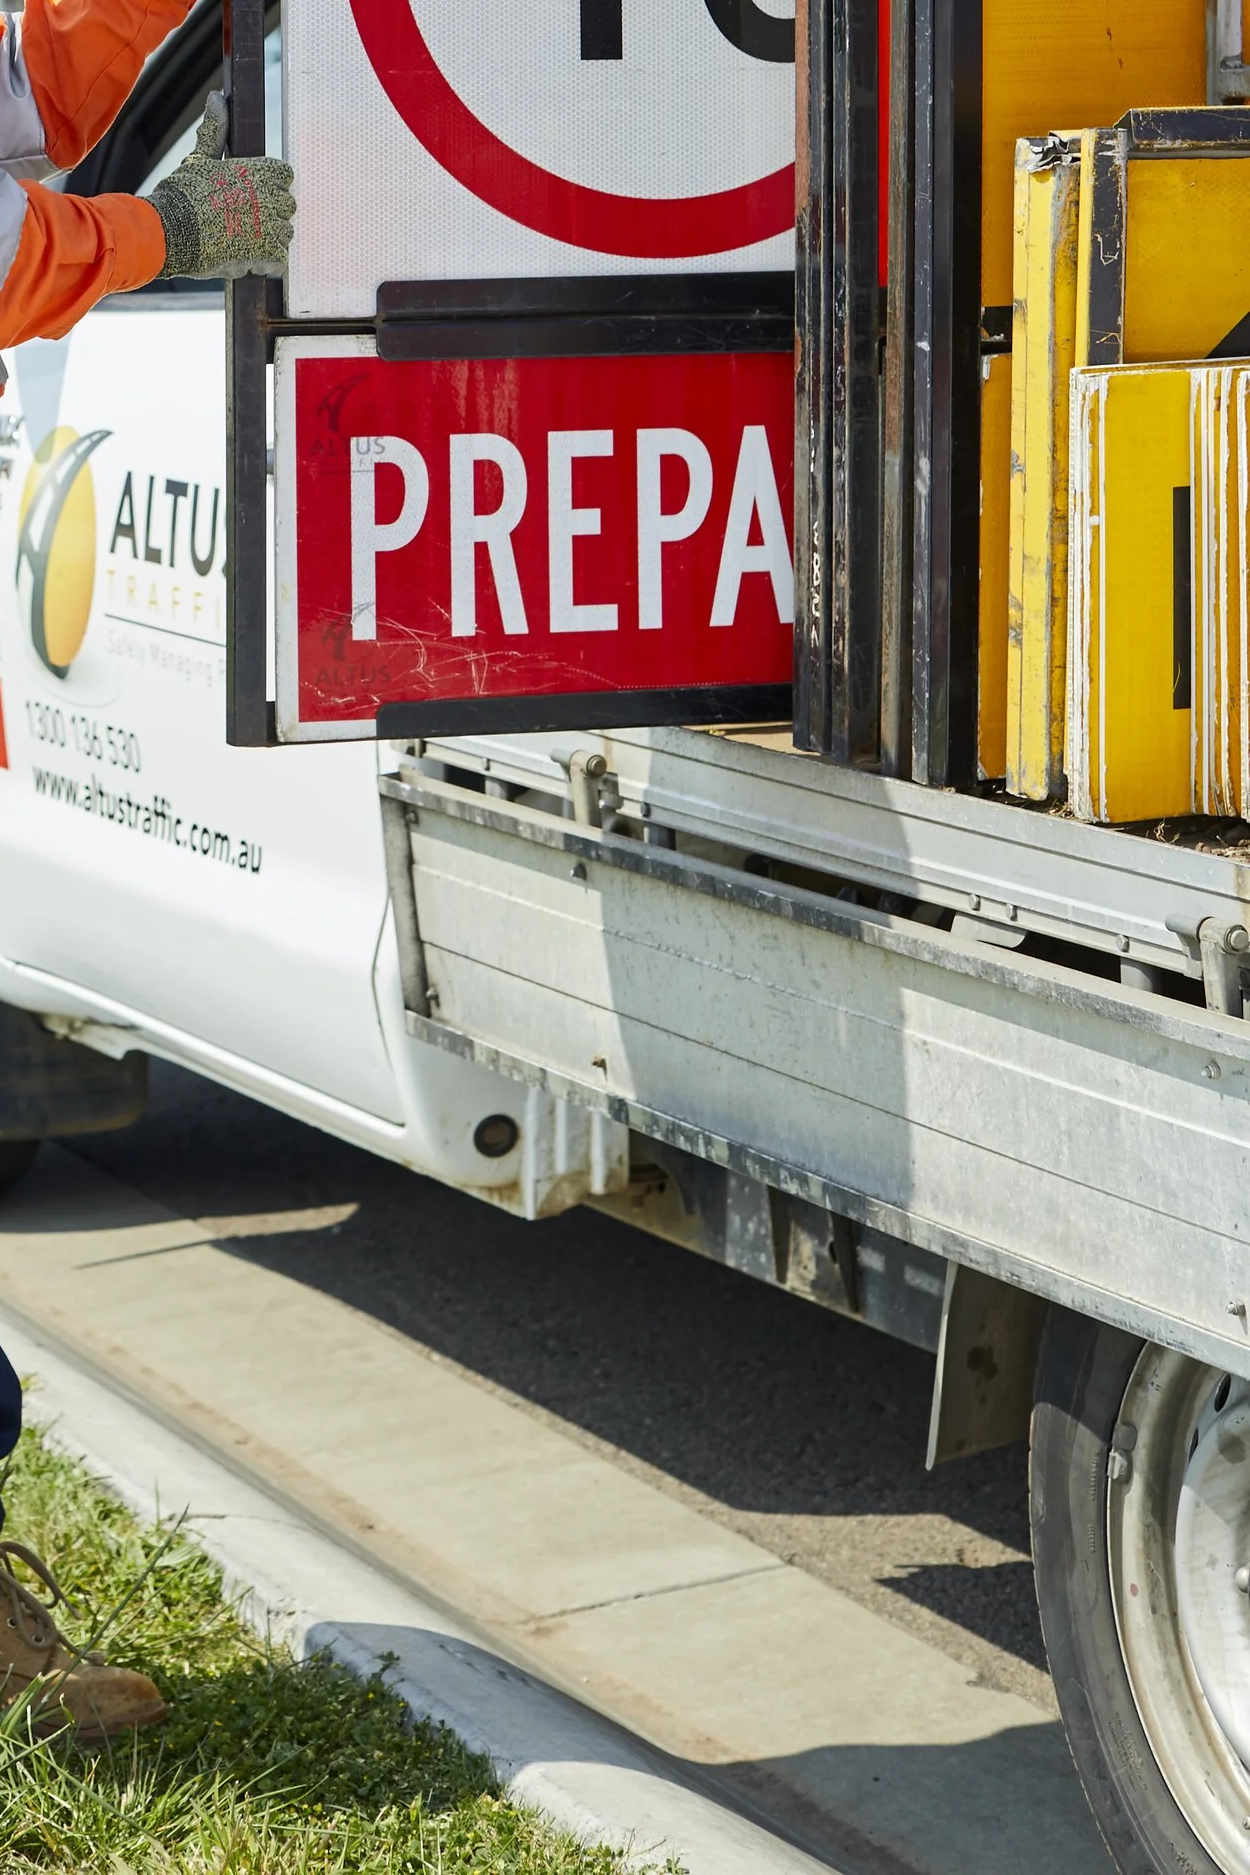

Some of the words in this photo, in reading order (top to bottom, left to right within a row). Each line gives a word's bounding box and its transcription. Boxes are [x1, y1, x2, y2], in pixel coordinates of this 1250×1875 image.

[109, 470, 227, 579] ALTU
[25, 700, 67, 749] 1300
[70, 715, 103, 760] 136
[106, 725, 142, 774] 530
[32, 765, 263, 875] www.altustraffic.com.au
